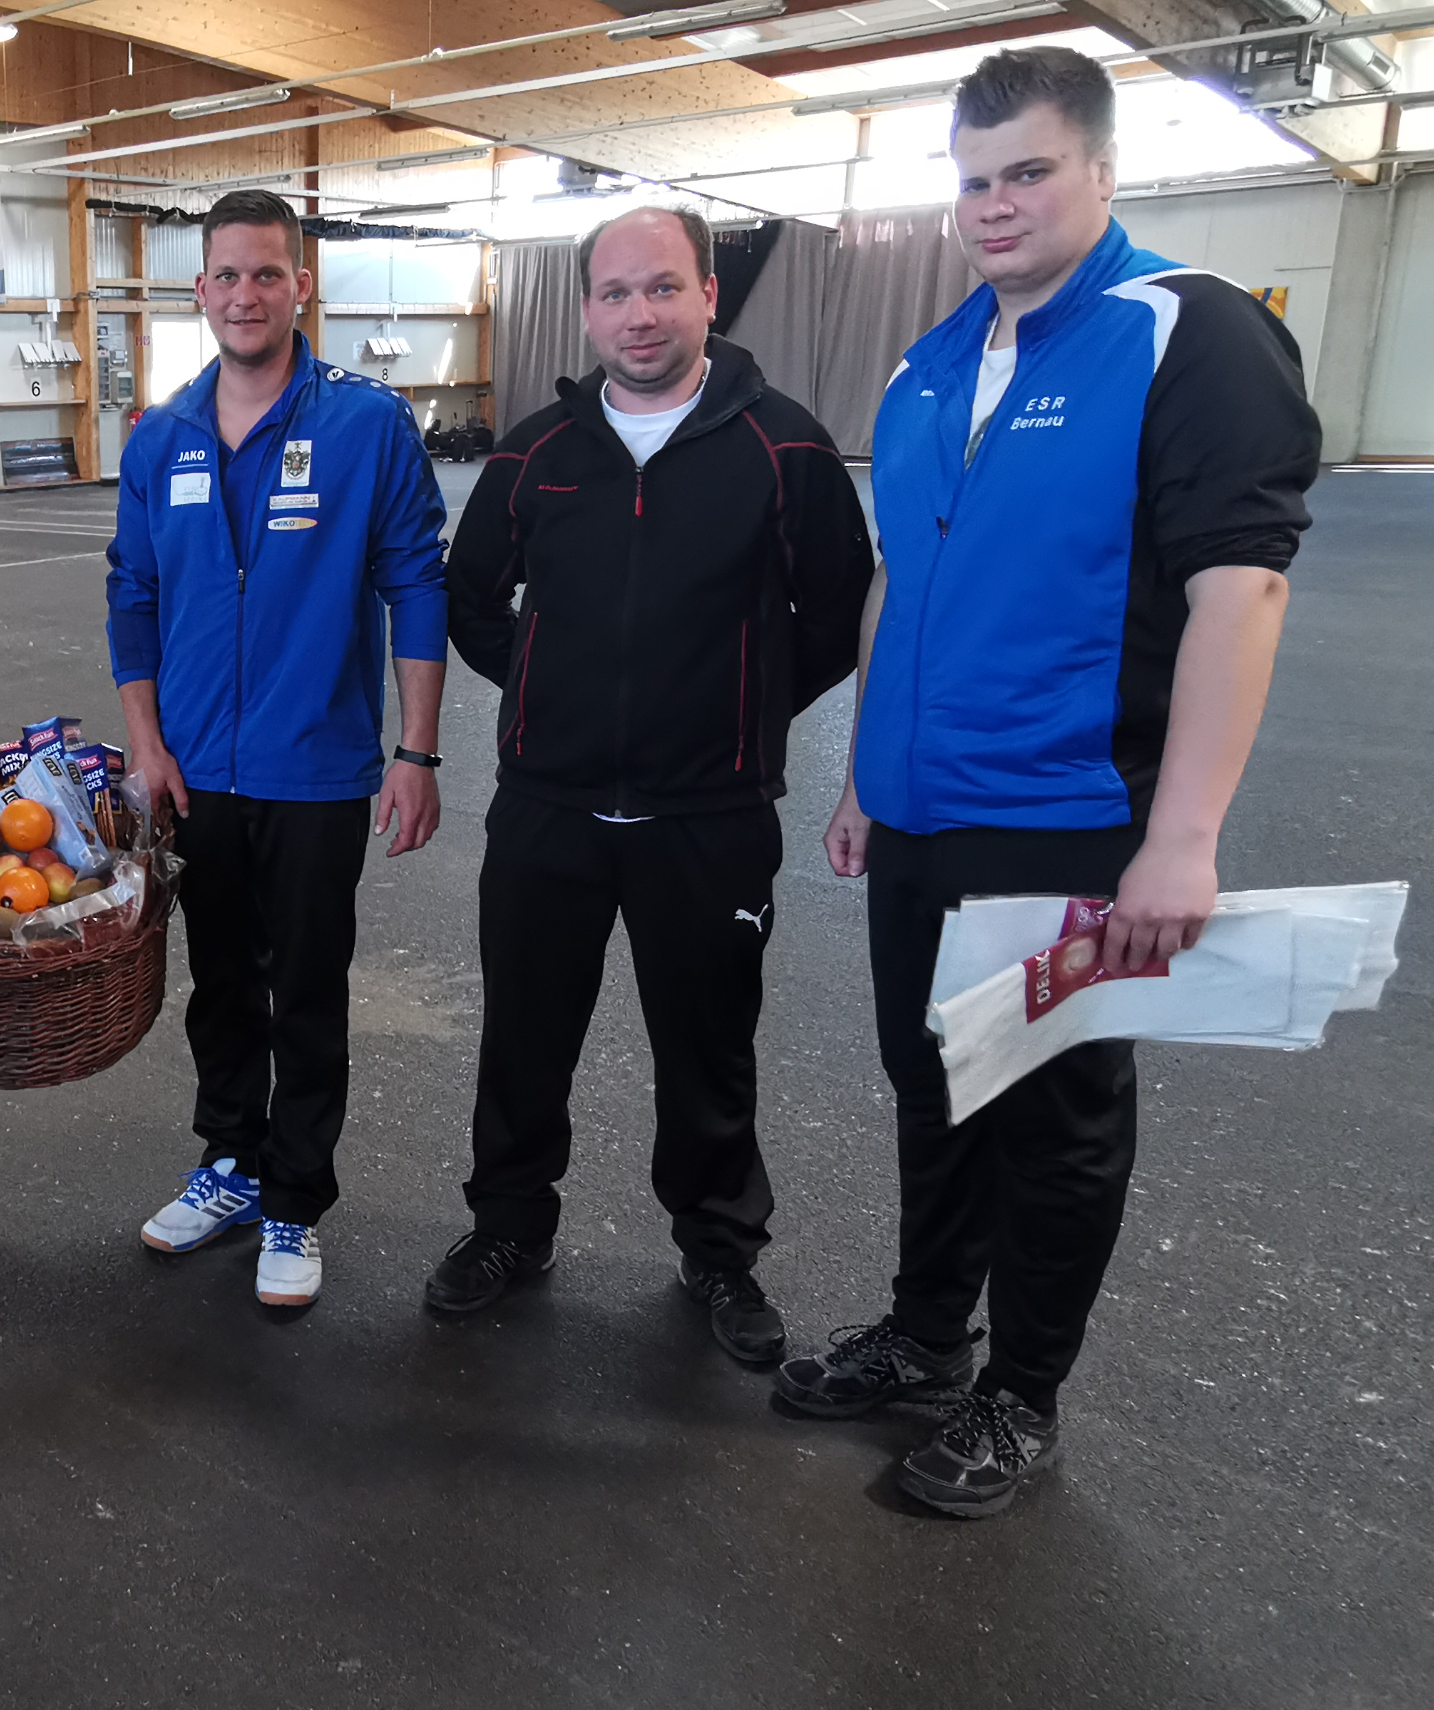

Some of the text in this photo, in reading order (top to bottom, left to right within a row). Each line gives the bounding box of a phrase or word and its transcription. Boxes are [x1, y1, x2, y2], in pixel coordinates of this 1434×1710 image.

[382, 368, 388, 381] 8
[31, 381, 41, 397] 6
[1025, 396, 1066, 412] ESR
[1010, 415, 1065, 431] Bernau
[178, 450, 206, 463] JAKO
[2, 761, 21, 776] MIX
[86, 778, 103, 791] CKS
